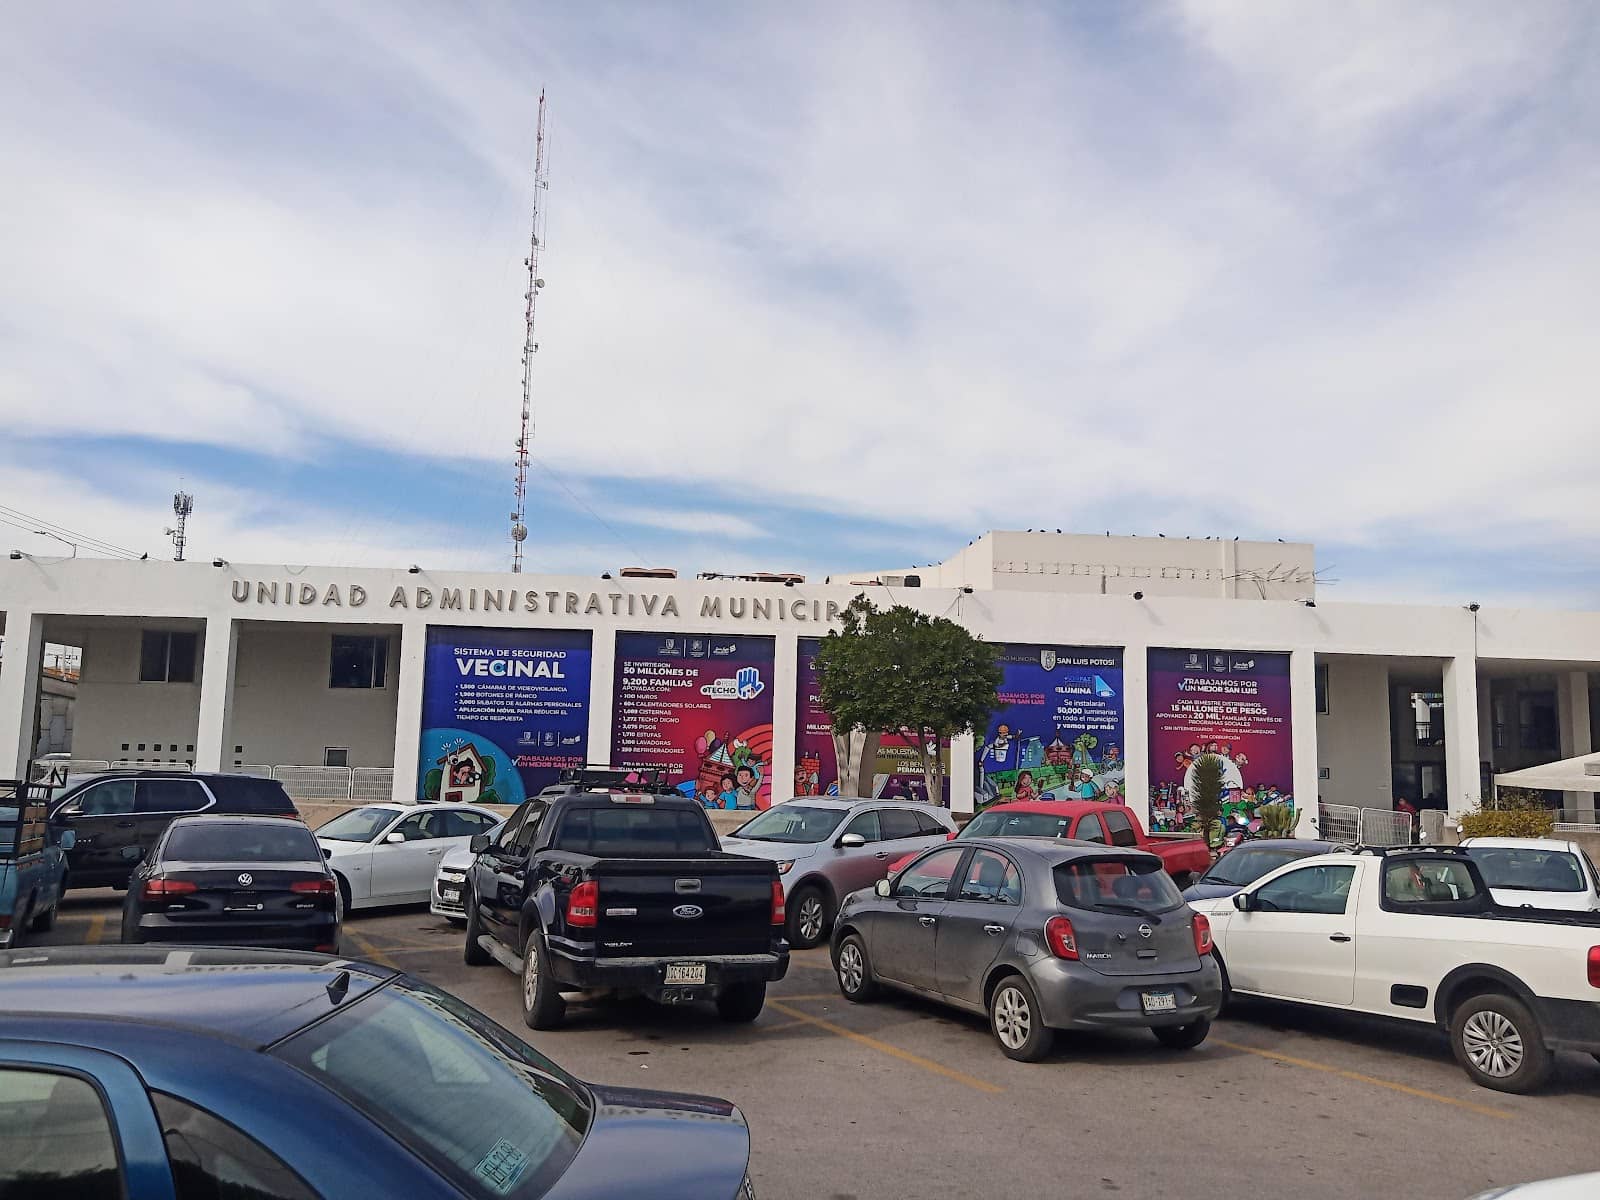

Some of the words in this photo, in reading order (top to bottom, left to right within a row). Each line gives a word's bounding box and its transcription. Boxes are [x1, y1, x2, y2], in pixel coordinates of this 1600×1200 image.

[231, 580, 368, 606] UNIDAD
[389, 585, 680, 617] ADMINISTRATIVA
[700, 595, 839, 621] MUNICIP
[454, 648, 494, 656] SISTEMA
[512, 650, 566, 658] SEGURIDAD
[456, 658, 565, 678] VECINAL
[638, 668, 684, 676] MILLONES
[622, 678, 648, 686] 9,200
[650, 679, 693, 688] FAMILIAS
[1184, 678, 1239, 686] TRABAJAMOS
[1182, 704, 1224, 713] MILLONES
[680, 906, 697, 915] Ford
